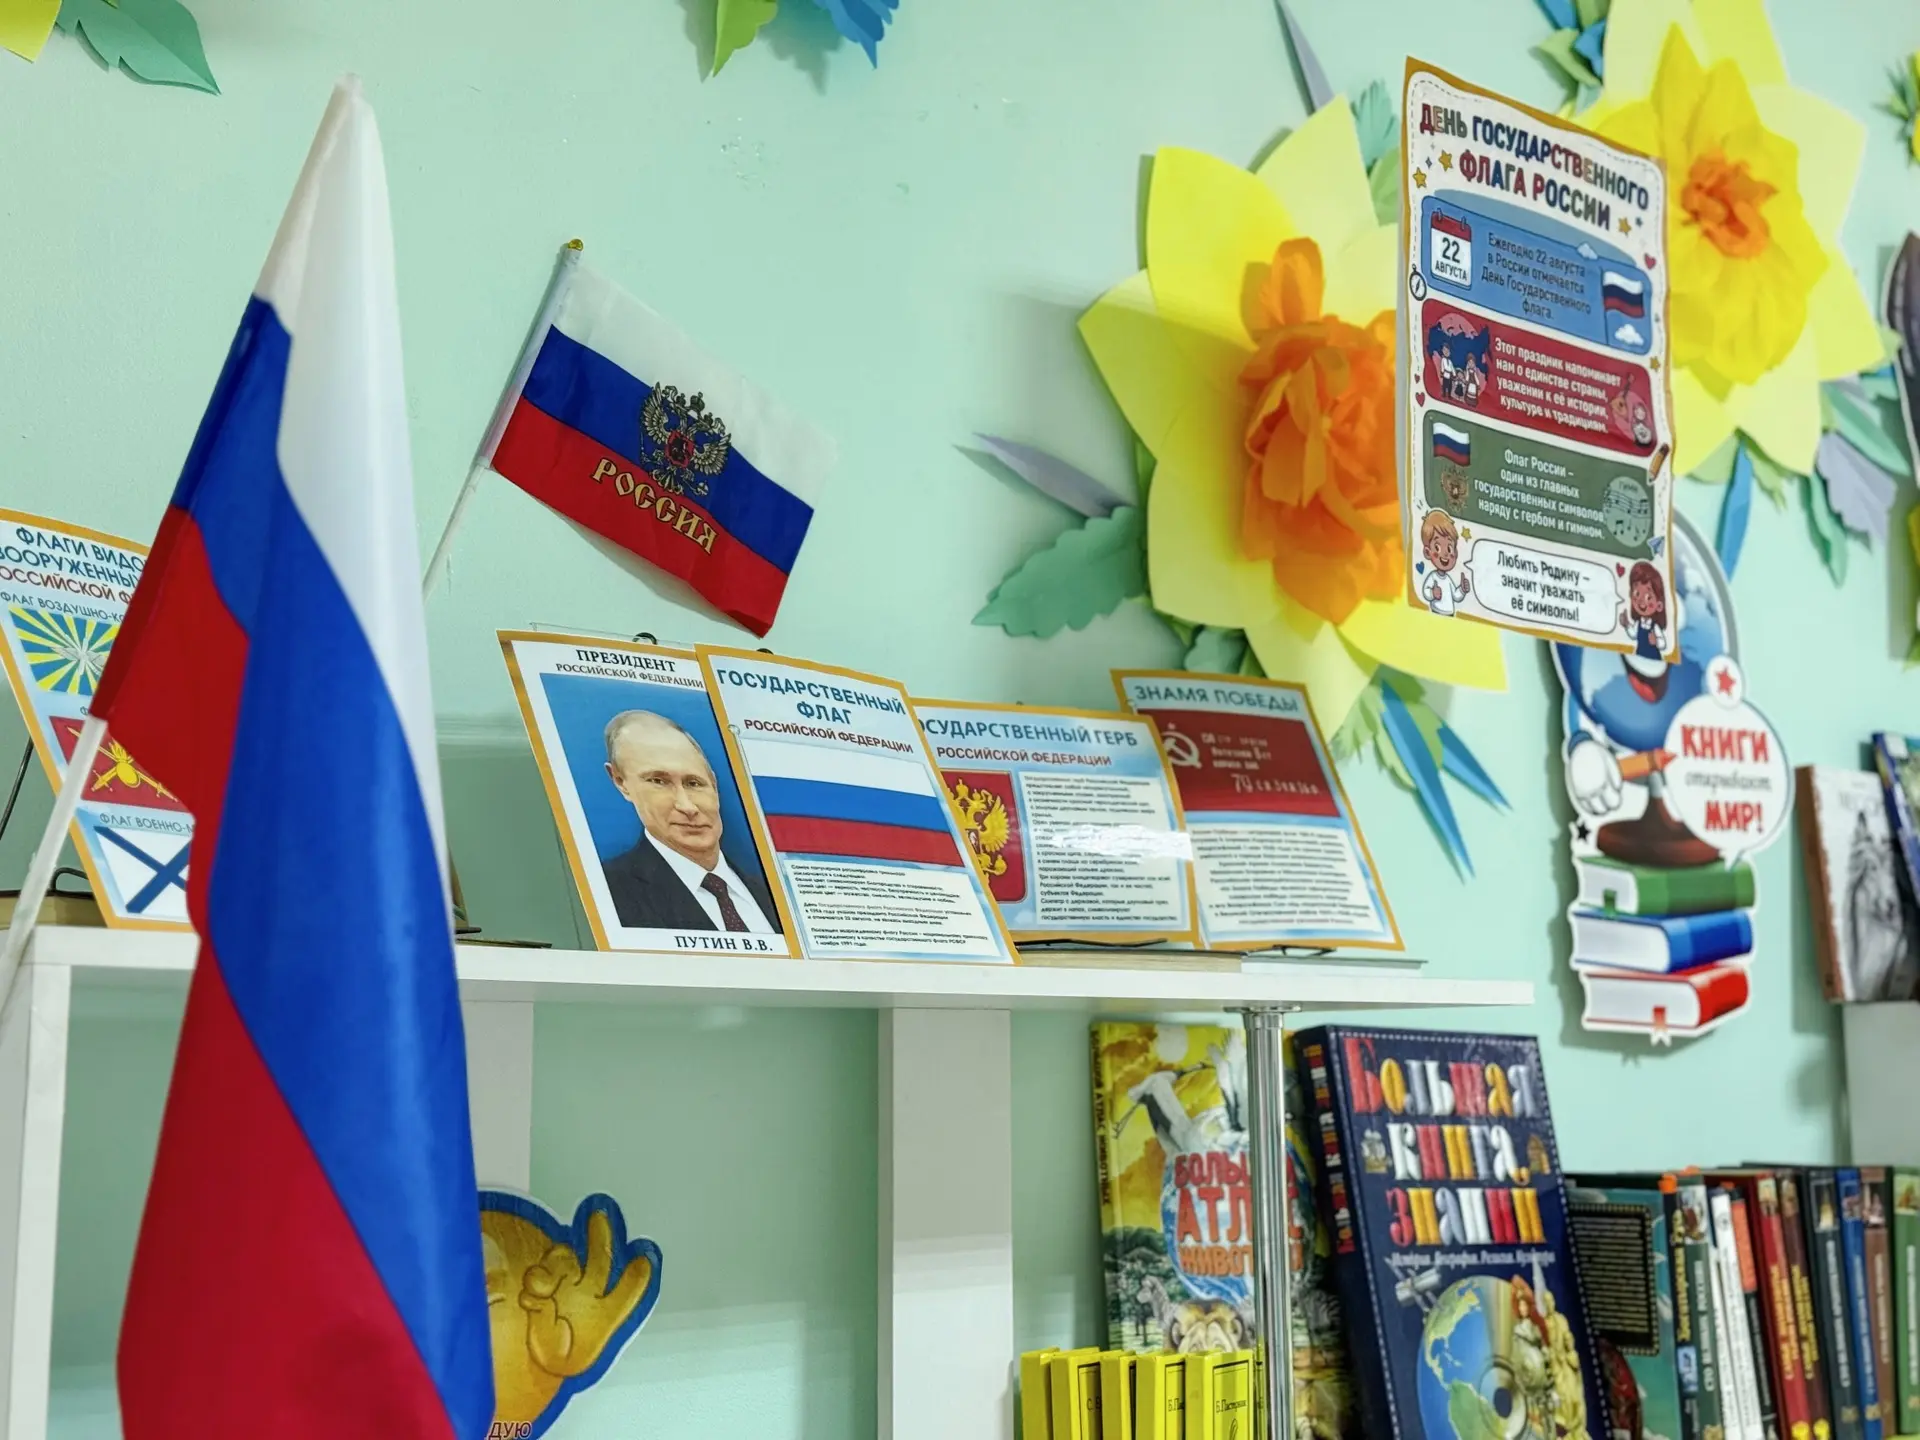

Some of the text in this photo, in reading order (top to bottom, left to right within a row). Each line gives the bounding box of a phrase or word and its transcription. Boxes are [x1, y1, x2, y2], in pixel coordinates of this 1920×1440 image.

[1420, 103, 1649, 211] ДЕНЬ ГОСУДАРСТВЕННОГО
[1459, 149, 1611, 231] ФЛАГА РОССИИ
[1442, 237, 1461, 264] 22
[1488, 232, 1586, 278] Ежегодно 22 августа
[1435, 260, 1467, 282] АВГУСТА
[1487, 252, 1585, 294] в России отмечается
[1481, 266, 1592, 315] День Государственного
[1495, 337, 1621, 387] Этот праздник напоминает
[1496, 358, 1515, 372] нам
[1516, 365, 1523, 376] о
[1525, 367, 1569, 390] единстве
[1496, 376, 1544, 400] уважении
[1545, 391, 1552, 402] к
[1500, 395, 1543, 417] культуре
[1544, 408, 1552, 418] и
[1505, 449, 1529, 467] Флаг
[1531, 456, 1566, 477] России
[1474, 479, 1557, 511] государственных
[1500, 469, 1580, 499] один из главных
[590, 457, 719, 555] РОССИЯ
[1478, 499, 1511, 520] наряду
[1513, 509, 1519, 520] с
[1521, 510, 1556, 529] гербом
[1557, 519, 1564, 530] и
[16, 527, 146, 573] ФЛАГИ ВИДО
[0, 545, 139, 589] ООРУЖЕННЫ
[1498, 550, 1538, 573] Любить
[1541, 560, 1580, 585] Родину
[0, 565, 116, 601] ОССИЙСКОЙ
[1, 592, 33, 605] ФЛАГ
[1501, 574, 1585, 603] значит уважать
[1511, 594, 1579, 622] её символы!
[556, 663, 704, 688] РОССИЙСКОЙ ФЕДЕРАЦИИ
[576, 649, 675, 672] ПРЕЗИДЕНТ
[717, 669, 907, 716] ГОСУДАРСТВЕННЫЙ
[1134, 685, 1298, 712] ЗНАМЯ ПОБЕДЫ
[797, 701, 851, 725] ФЛАГ
[744, 719, 914, 754] РОССИЙСКОЙ ФЕДЕРАЦИИ
[917, 718, 1138, 747] СУДАРСТВЕННЫЙ ГЕРБ
[1681, 724, 1769, 763] КНИГИ
[937, 746, 1112, 766] РОССИЙСКОЙ ФЕДЕРАЦИИ
[100, 813, 131, 826] ФЛАГ
[1705, 800, 1763, 833] МИР!
[674, 935, 773, 951] ПУТИН В.В.
[1175, 1151, 1298, 1188] БОЛЬ
[1177, 1185, 1304, 1242] АТЛС
[488, 1422, 531, 1440] ДУЮ
